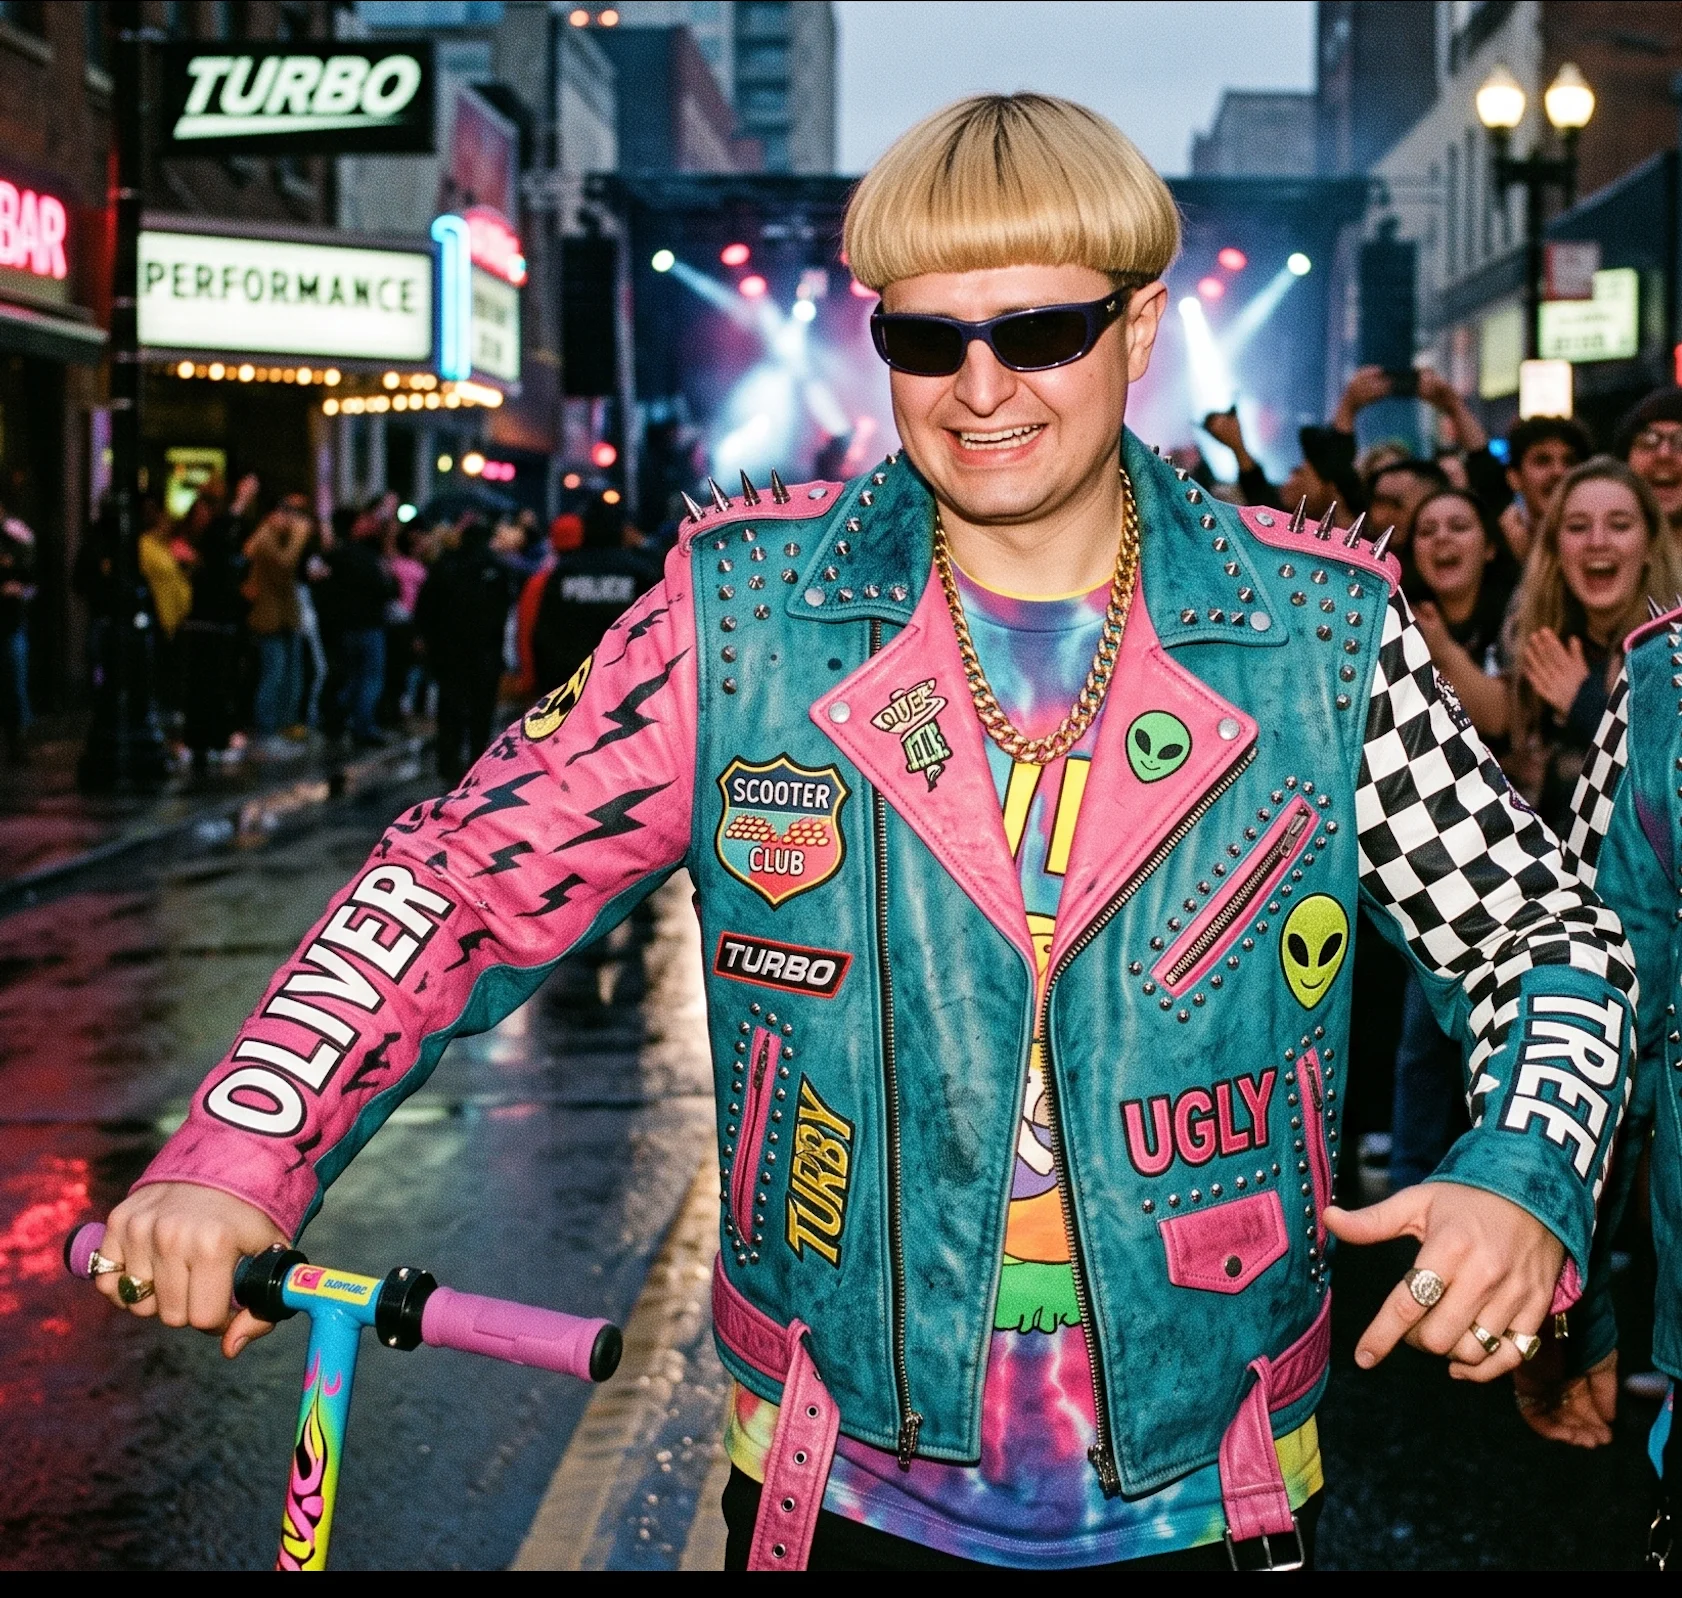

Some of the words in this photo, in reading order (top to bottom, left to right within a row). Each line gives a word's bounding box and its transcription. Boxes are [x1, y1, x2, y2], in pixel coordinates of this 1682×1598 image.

[187, 55, 421, 115] TURBO
[0, 180, 67, 280] BAR
[146, 262, 416, 314] PERFORMANCE
[733, 778, 830, 809] SCOOTER
[749, 846, 805, 876] CLUB
[205, 864, 454, 1137] OLIVER
[725, 941, 836, 986] TURBO
[1121, 1067, 1277, 1177] UGLY
[1503, 995, 1625, 1180] TREE
[787, 1076, 852, 1266] TURBY
